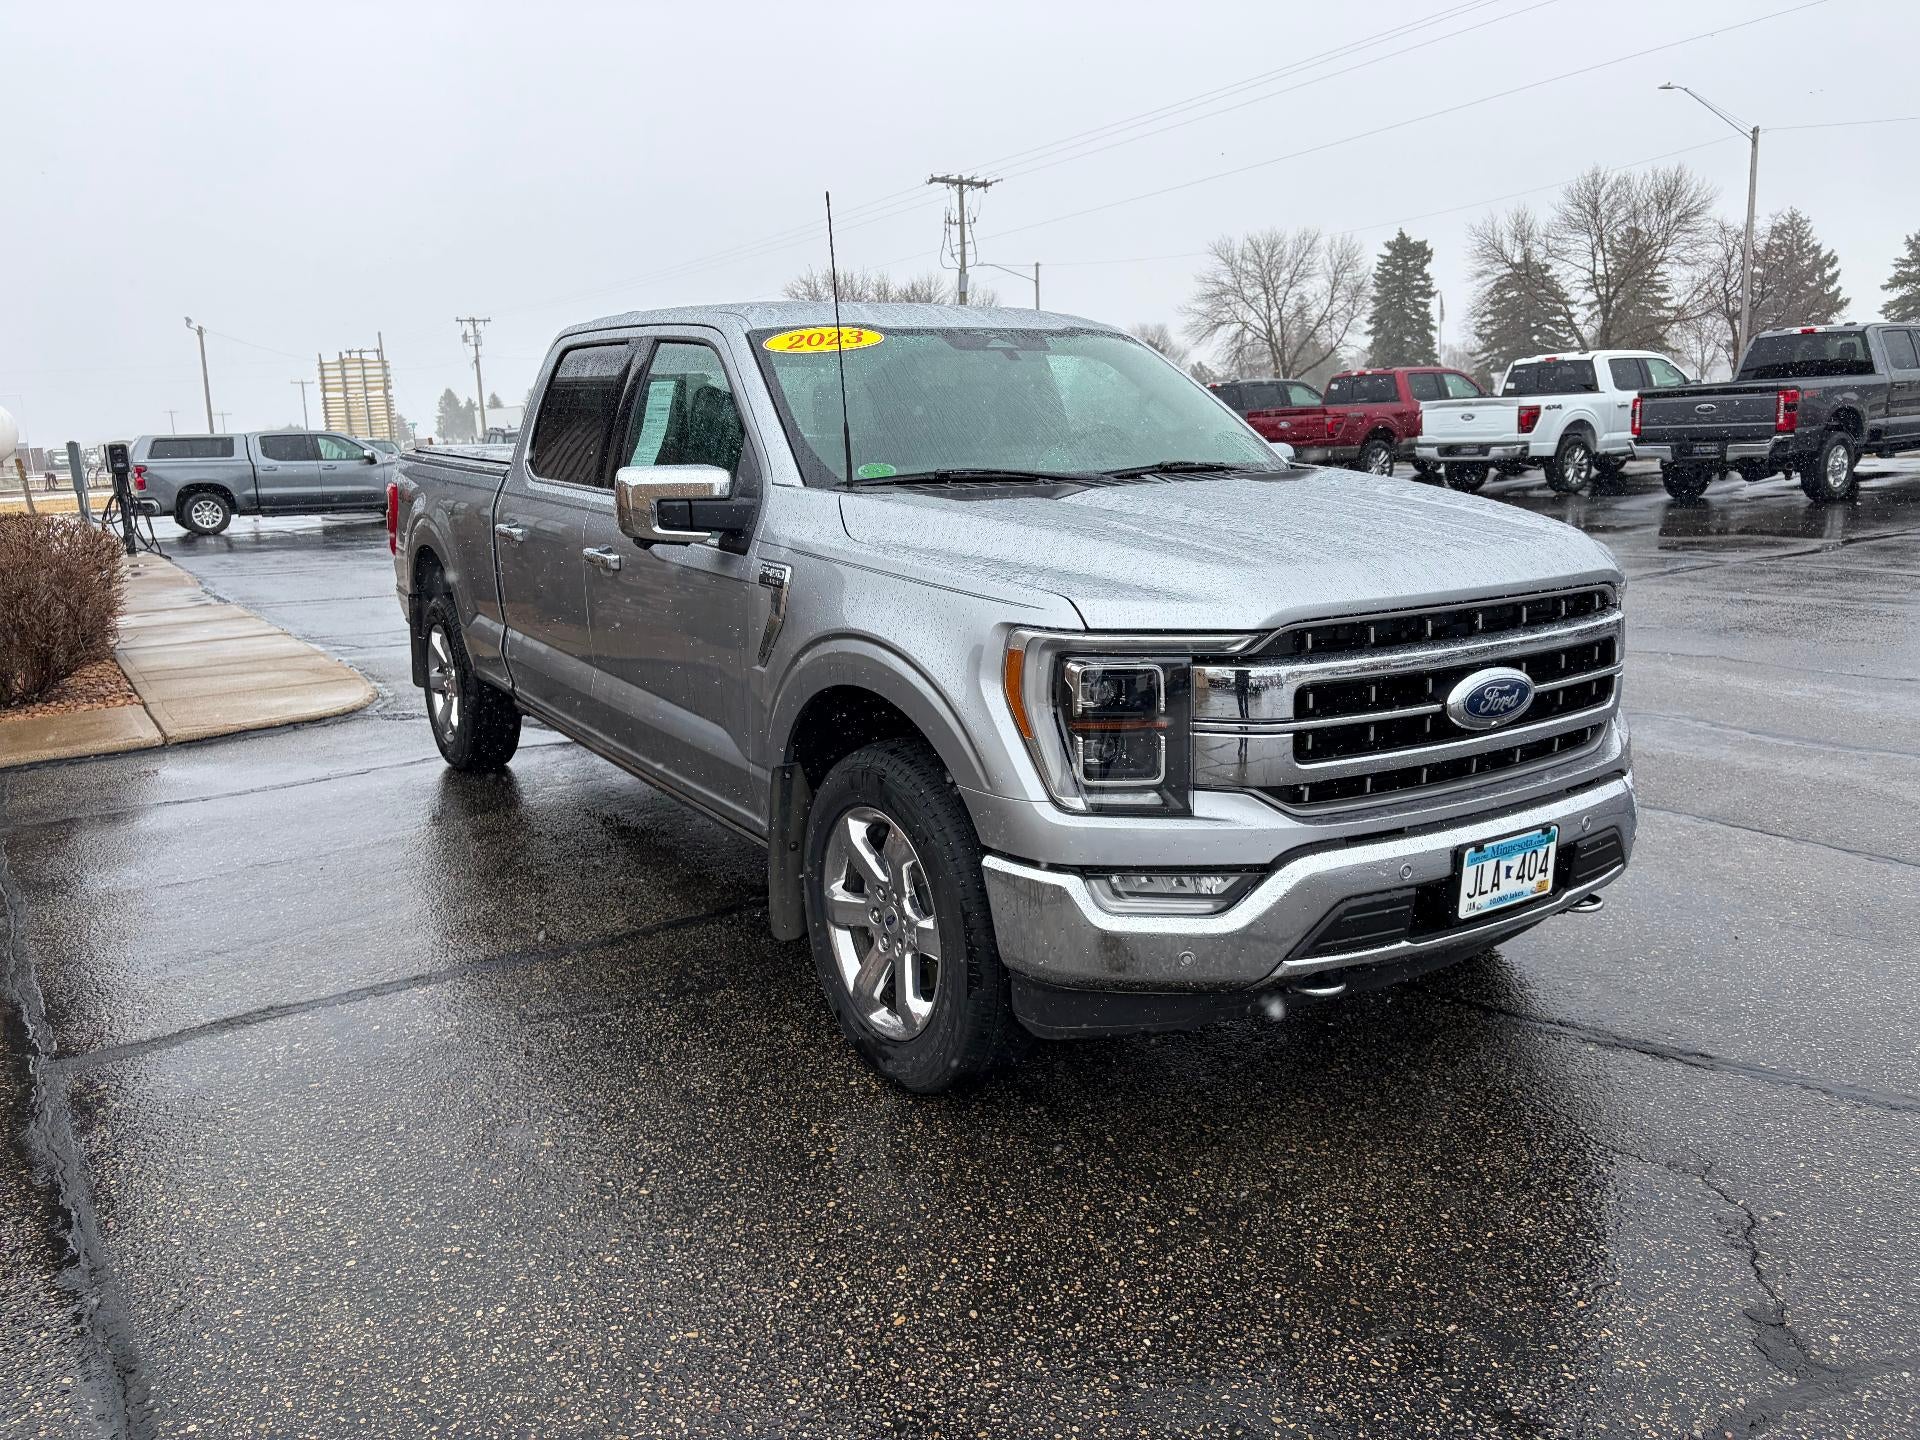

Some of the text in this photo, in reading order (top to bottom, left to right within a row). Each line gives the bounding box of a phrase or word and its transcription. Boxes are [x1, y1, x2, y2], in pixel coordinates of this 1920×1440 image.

[787, 330, 864, 349] 2023
[1480, 684, 1520, 713] Ford
[1466, 846, 1550, 899] JLA 404
